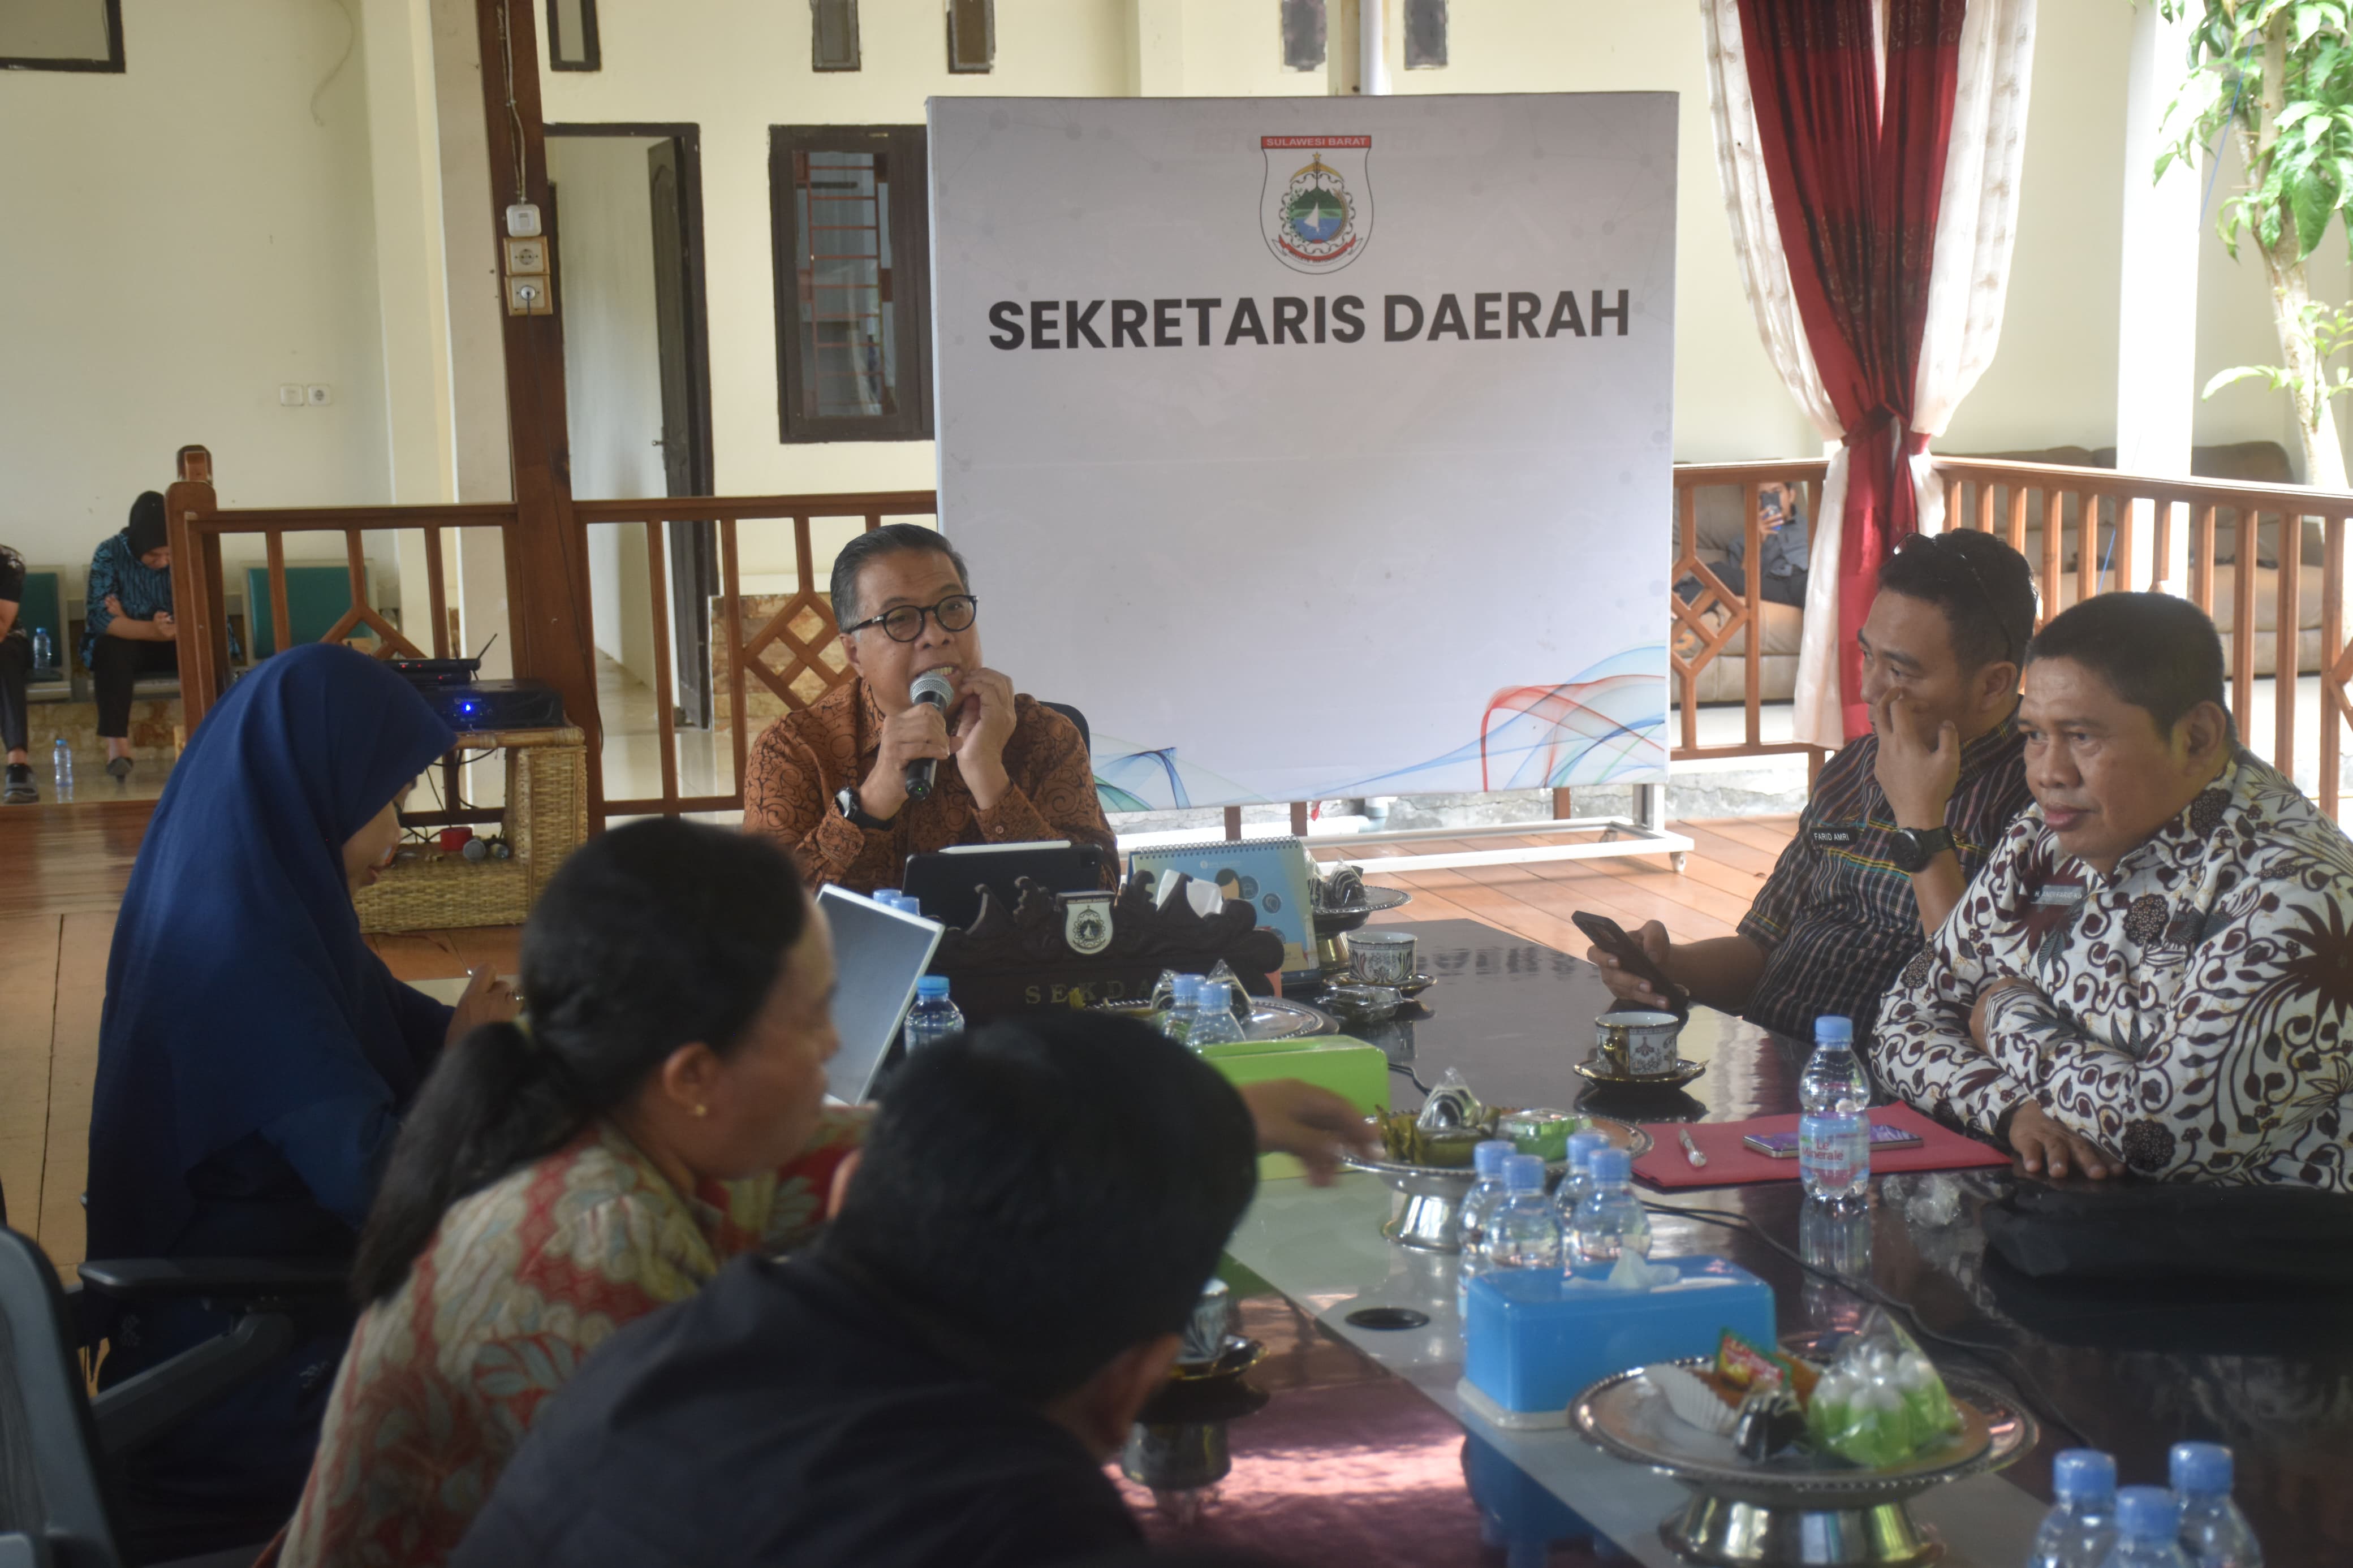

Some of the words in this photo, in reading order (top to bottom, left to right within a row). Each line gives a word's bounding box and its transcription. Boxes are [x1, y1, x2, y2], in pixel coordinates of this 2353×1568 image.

[1266, 138, 1325, 146] SULAWESI
[1328, 137, 1367, 146] BARAT
[988, 295, 1366, 351] SEKRETARIS
[1384, 289, 1630, 342] DAERAH
